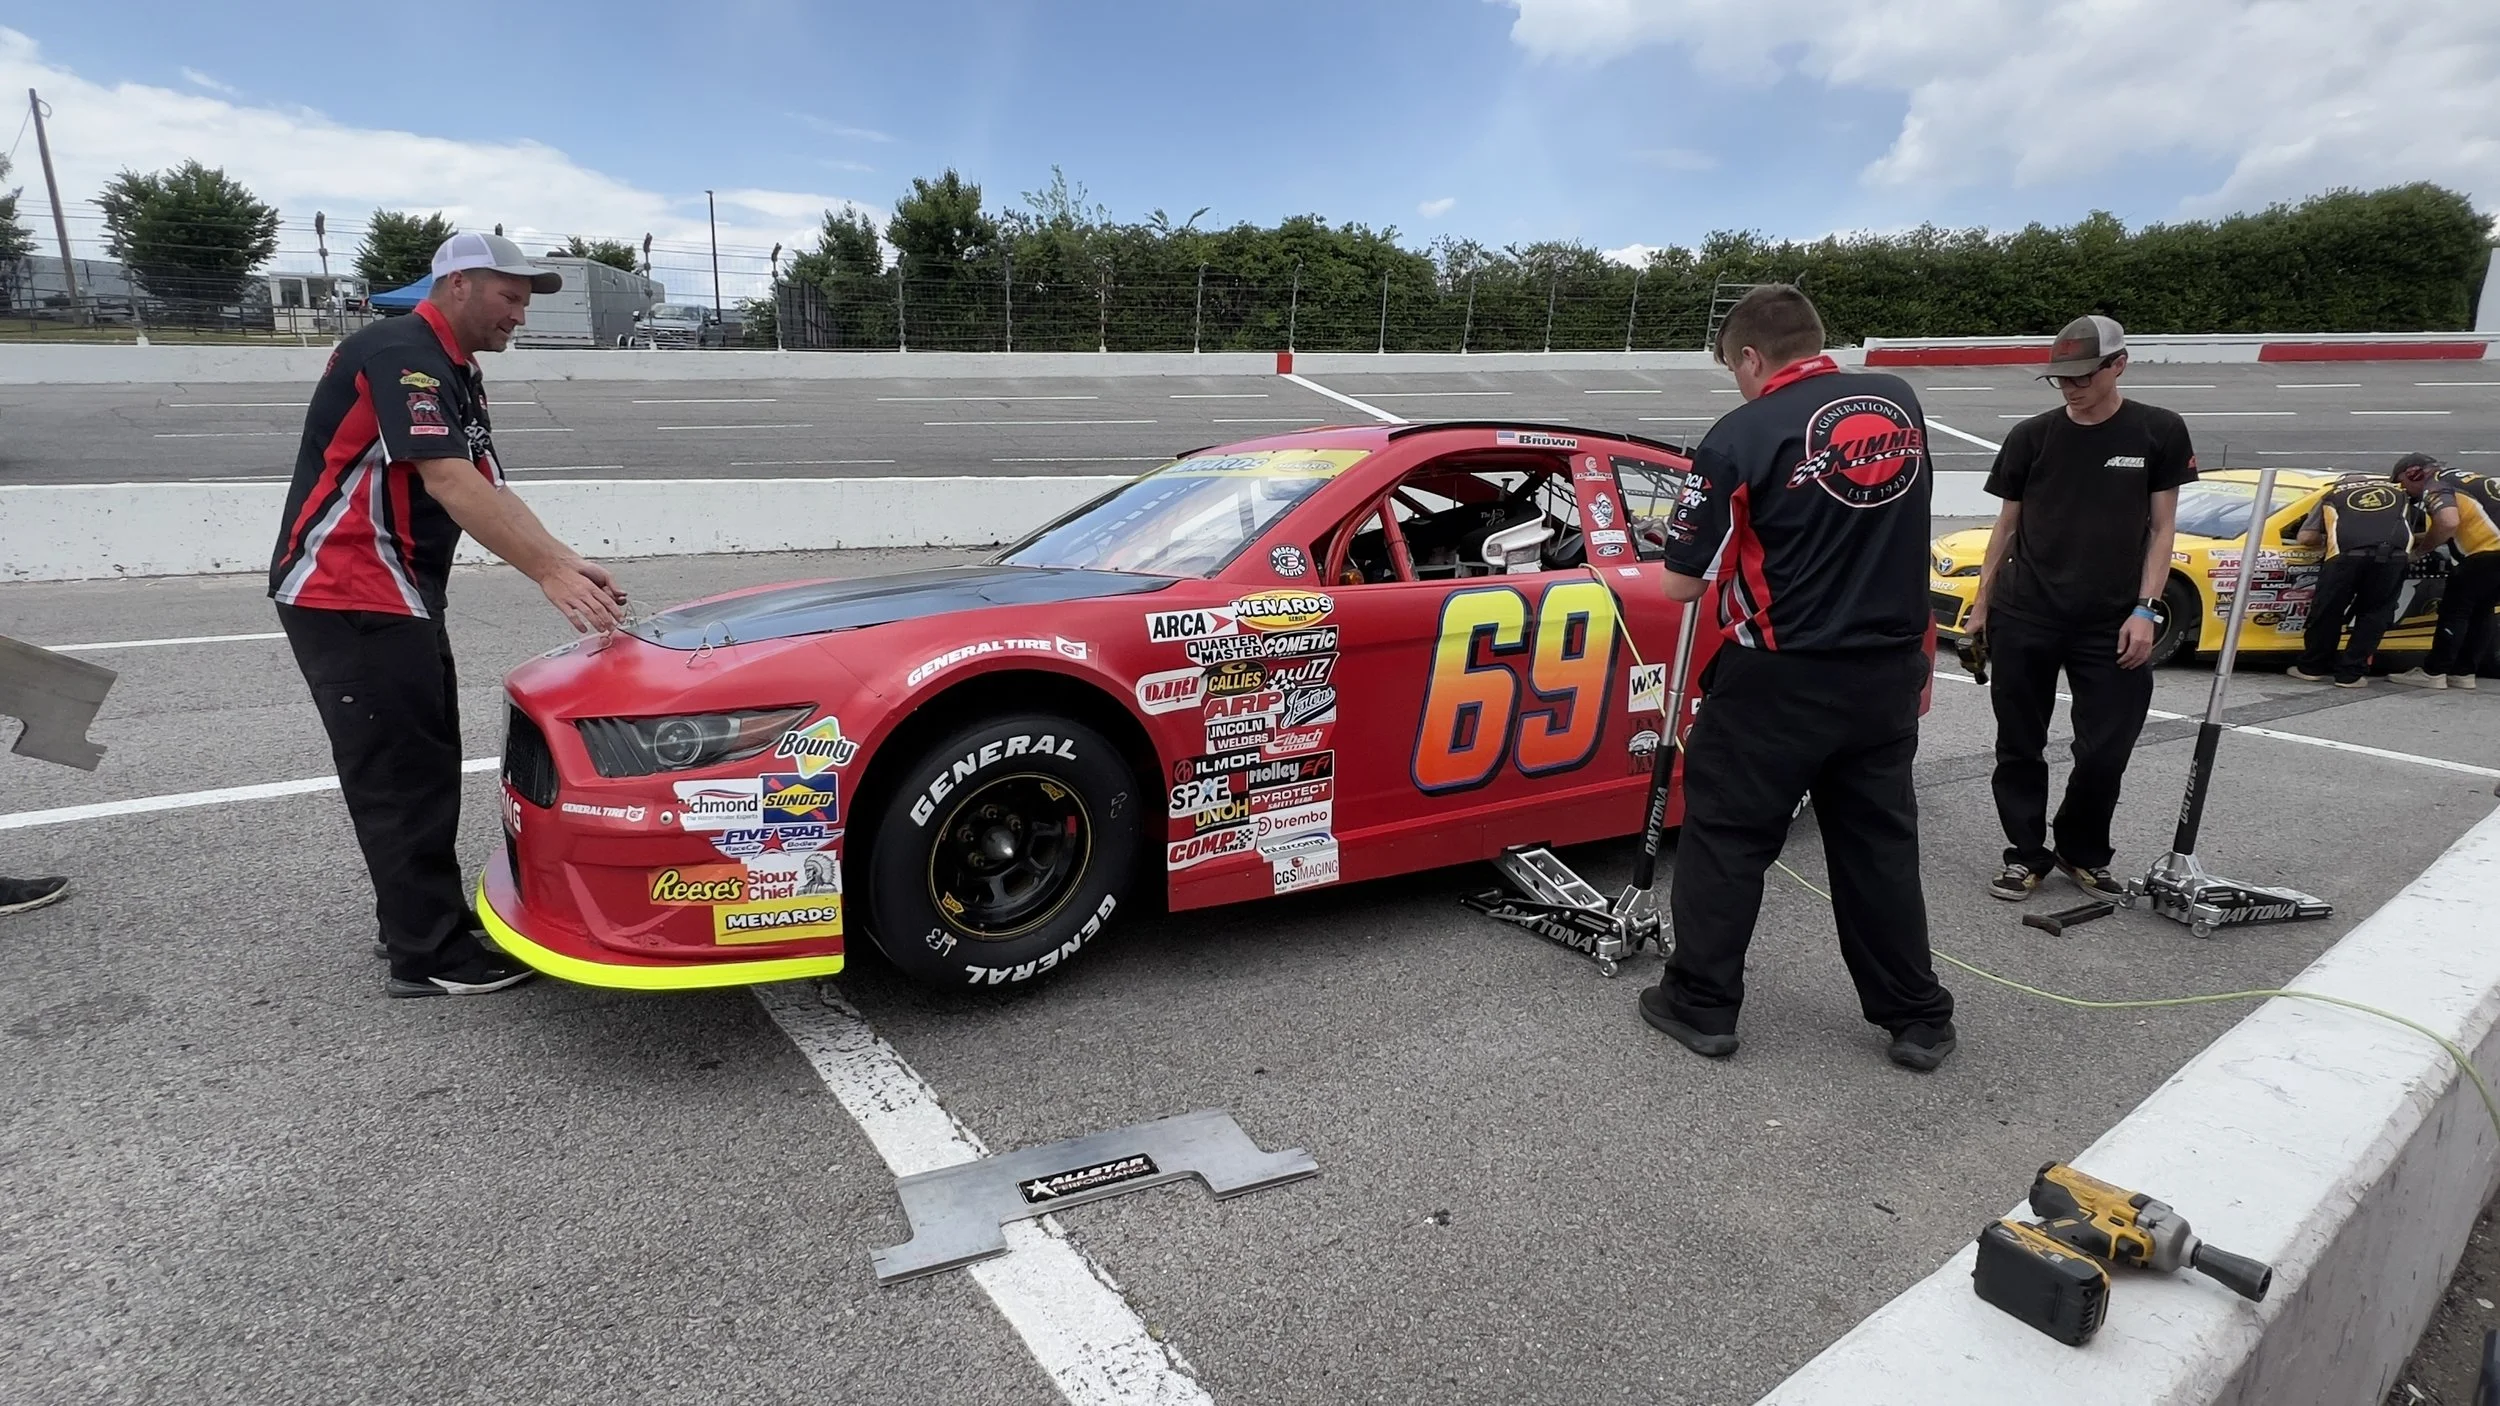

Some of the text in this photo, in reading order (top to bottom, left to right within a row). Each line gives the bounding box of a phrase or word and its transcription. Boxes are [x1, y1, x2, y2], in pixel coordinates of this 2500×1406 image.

[1819, 402, 1899, 429] GENERATIONS
[1518, 435, 1576, 447] BROWN
[1850, 448, 1923, 468] RACING
[1880, 475, 1907, 498] 1949
[1272, 546, 1301, 559] NASCAR
[1275, 564, 1306, 577] SALUTES
[1231, 597, 1333, 617] MENARDS
[1152, 612, 1207, 640] ARCA
[1187, 634, 1258, 658] QUARTER
[1263, 631, 1337, 655] COMETIC
[907, 639, 1005, 688] GENERAL
[1004, 638, 1052, 651] TIRE
[1201, 645, 1263, 665] MASTER
[1209, 671, 1262, 693] CALLIES
[1410, 580, 1622, 794] 69
[1631, 666, 1663, 696] WIX
[1204, 691, 1284, 719] ARP
[1281, 687, 1336, 729] Jostens
[781, 732, 856, 764] Bounty
[1217, 733, 1269, 749] WELDERS
[1267, 729, 1323, 752] Eibach
[1195, 752, 1262, 774] ILMOR
[909, 735, 1077, 827] GENERAL
[2179, 758, 2199, 825] DAYTONA
[765, 793, 832, 807] SUNOCO
[1251, 783, 1328, 806] PYROTECT
[562, 802, 601, 816] GENERAL
[602, 806, 628, 818] TIRE
[1195, 798, 1250, 827] UNOH
[1274, 811, 1328, 830] brembo
[1645, 786, 1669, 857] DAYTONA
[725, 825, 824, 844] FIVE STAR
[787, 840, 818, 848] Bodies
[1168, 831, 1237, 864] COMP
[1213, 842, 1247, 855] CAMS
[1260, 838, 1326, 855] Intercomp
[652, 868, 745, 903] Reese's
[747, 869, 799, 885] Sioux
[748, 883, 794, 901] Chief
[726, 907, 838, 931] MENARDS
[2217, 904, 2297, 924] DAYTONA
[964, 894, 1117, 985] GENERAL
[1501, 904, 1594, 953] DAYTONA
[1050, 1157, 1145, 1186] ALLSTAR
[1053, 1164, 1150, 1192] PERFORMANCE
